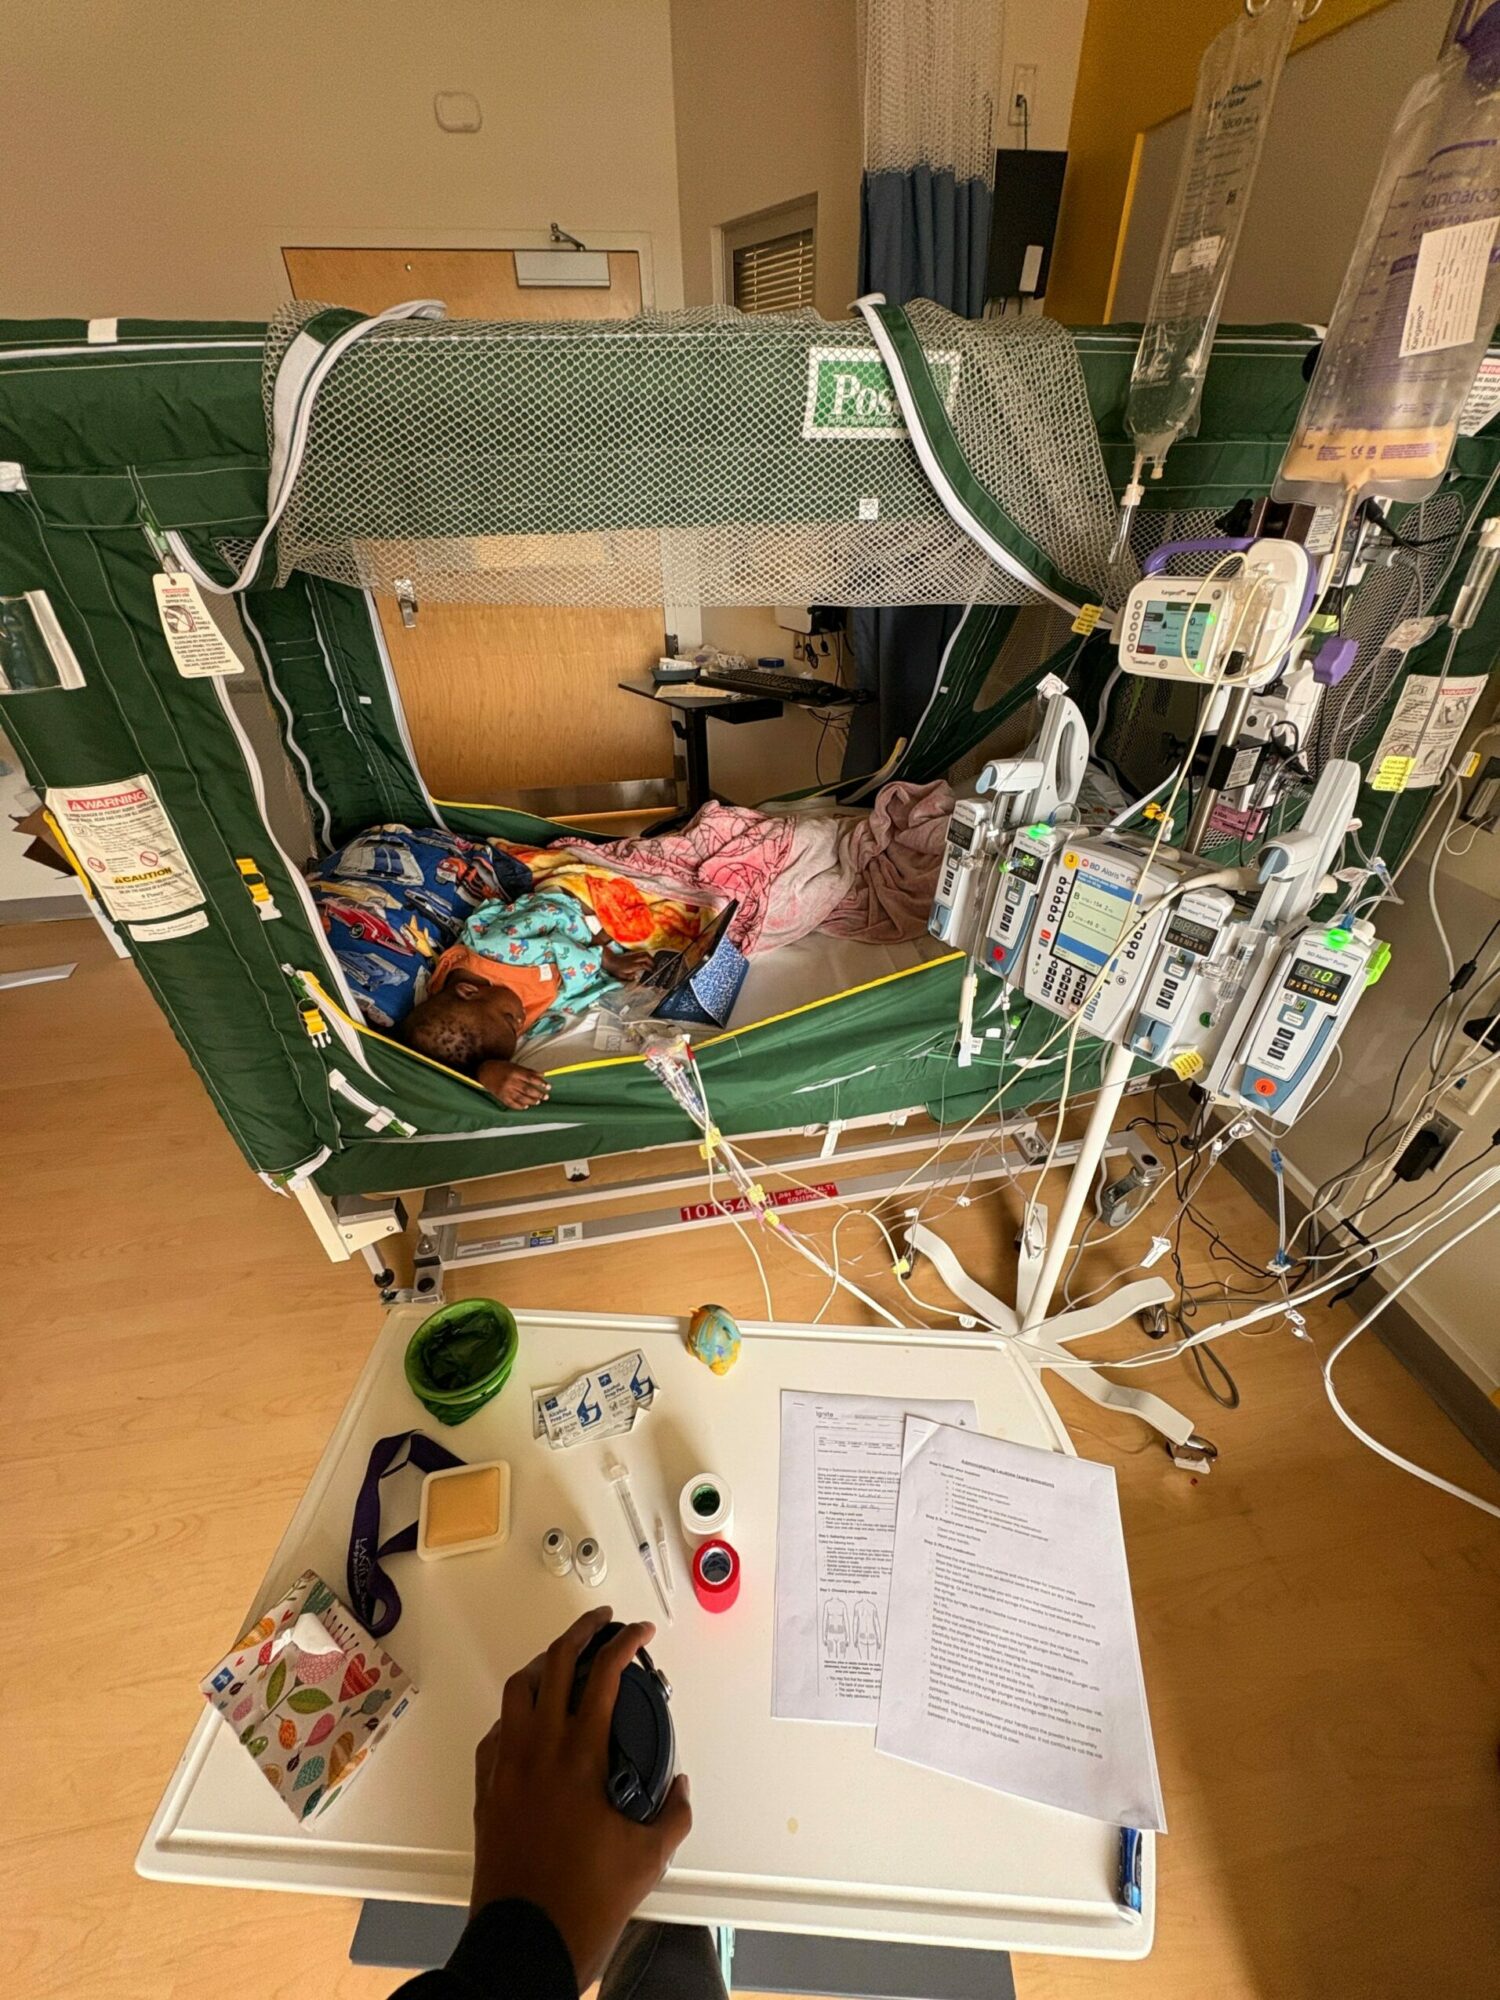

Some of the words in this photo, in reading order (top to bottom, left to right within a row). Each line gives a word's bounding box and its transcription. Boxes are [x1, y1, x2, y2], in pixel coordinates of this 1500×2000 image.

[83, 789, 146, 810] WARNING
[1068, 855, 1074, 863] 3
[122, 867, 172, 884] CAUTION
[1090, 862, 1100, 871] BD
[1126, 877, 1138, 886] PC
[1314, 969, 1333, 983] 10
[683, 1194, 775, 1220] 101544
[603, 1383, 621, 1394] Alcohol
[605, 1390, 616, 1399] Prep
[616, 1386, 625, 1394] Pad
[549, 1407, 567, 1417] Alcohol
[550, 1415, 563, 1424] Prep
[563, 1411, 572, 1419] Pad
